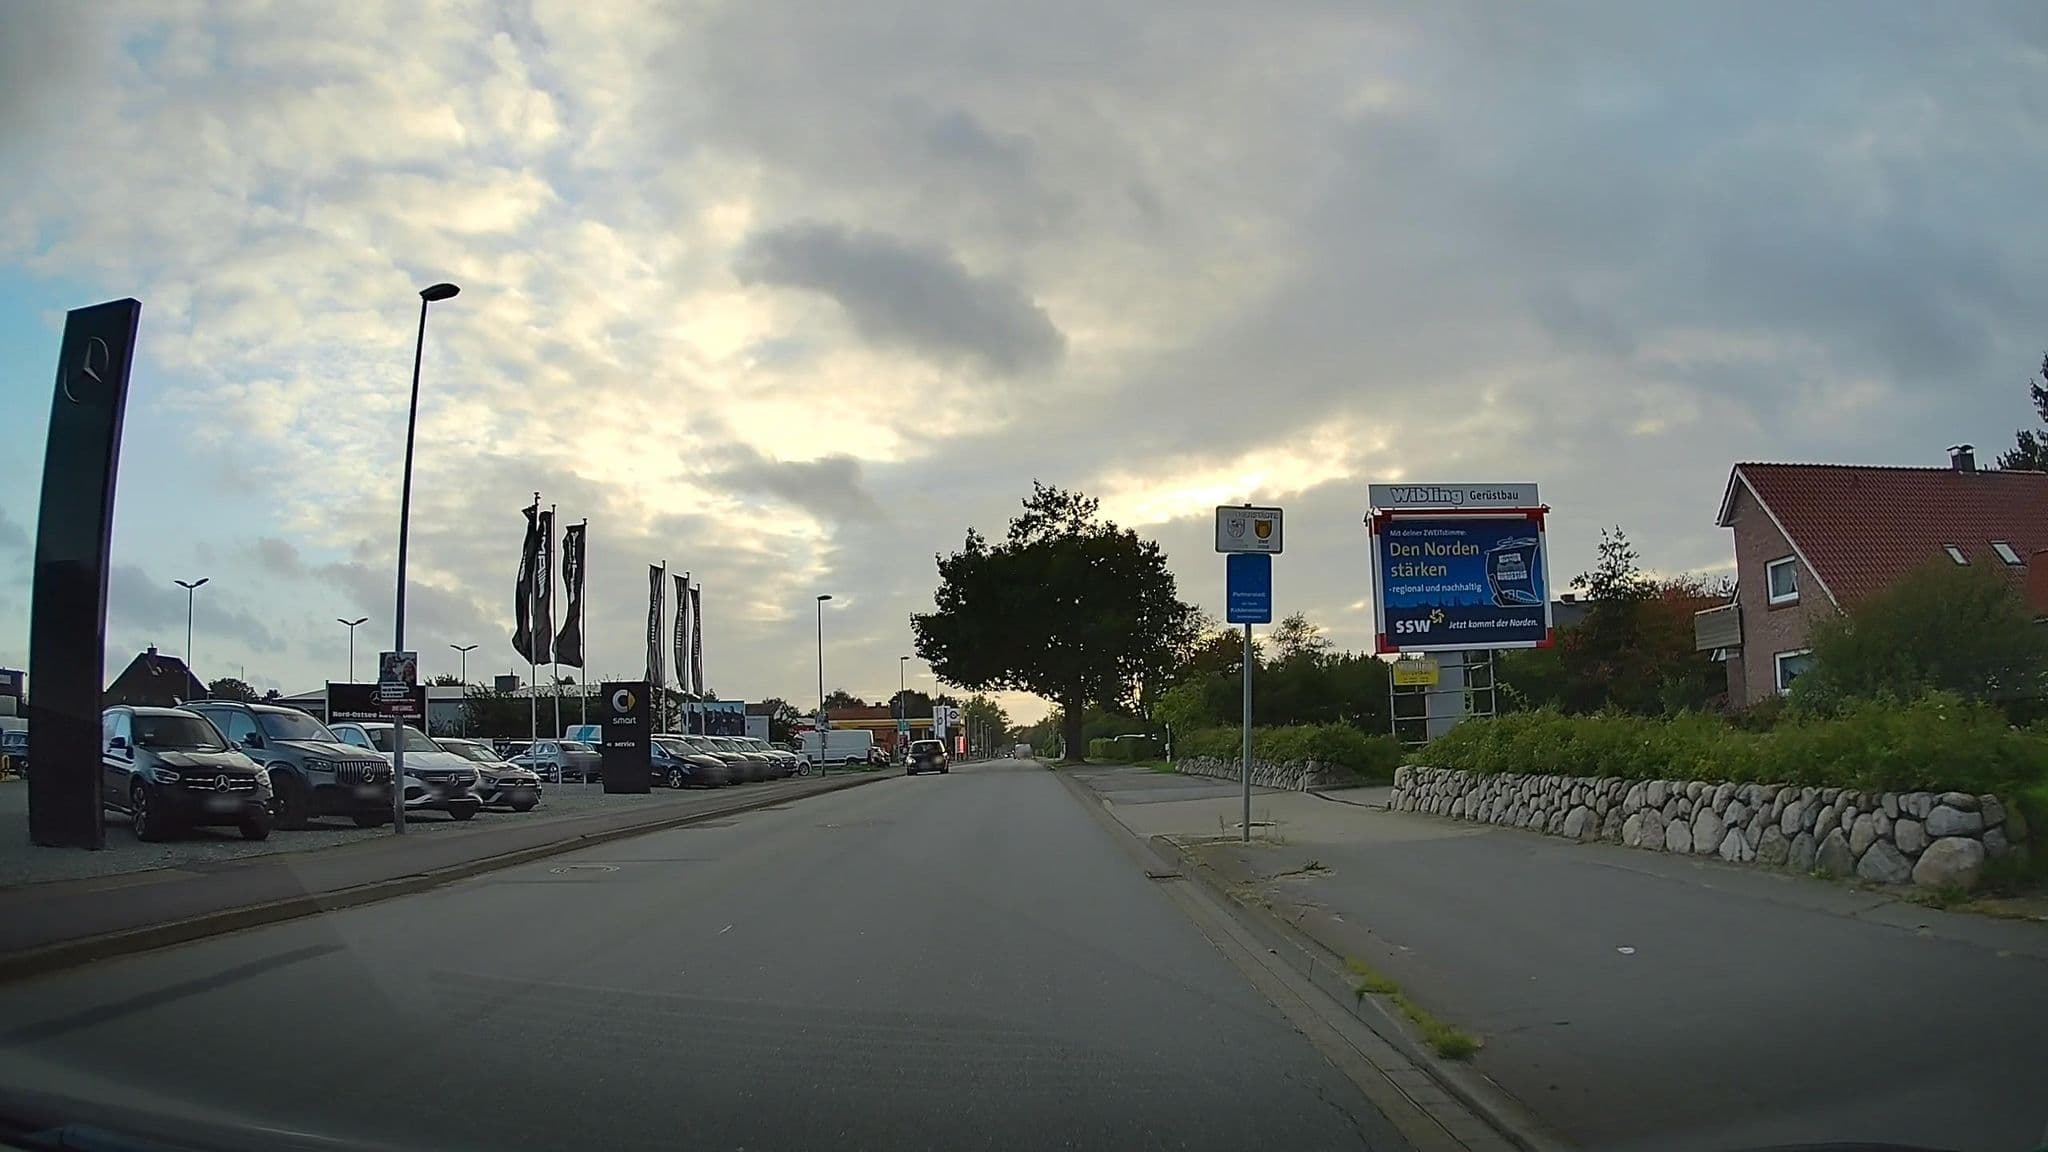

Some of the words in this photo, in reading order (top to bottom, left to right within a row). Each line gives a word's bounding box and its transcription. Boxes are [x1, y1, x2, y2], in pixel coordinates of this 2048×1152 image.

[1390, 487, 1463, 505] Wibling
[1470, 489, 1519, 501] Gerüstbau
[1389, 542, 1420, 557] Den
[1425, 540, 1479, 556] Norden
[1391, 561, 1447, 577] stärken
[1425, 583, 1440, 592] und
[1441, 582, 1482, 593] nachhaltig
[1395, 619, 1431, 633] SSW
[1449, 620, 1467, 629] Jetzt
[1468, 619, 1495, 628] kommt
[1496, 619, 1508, 628] der
[1509, 618, 1538, 627] Norden.
[612, 716, 637, 725] smart
[614, 740, 635, 748] service
